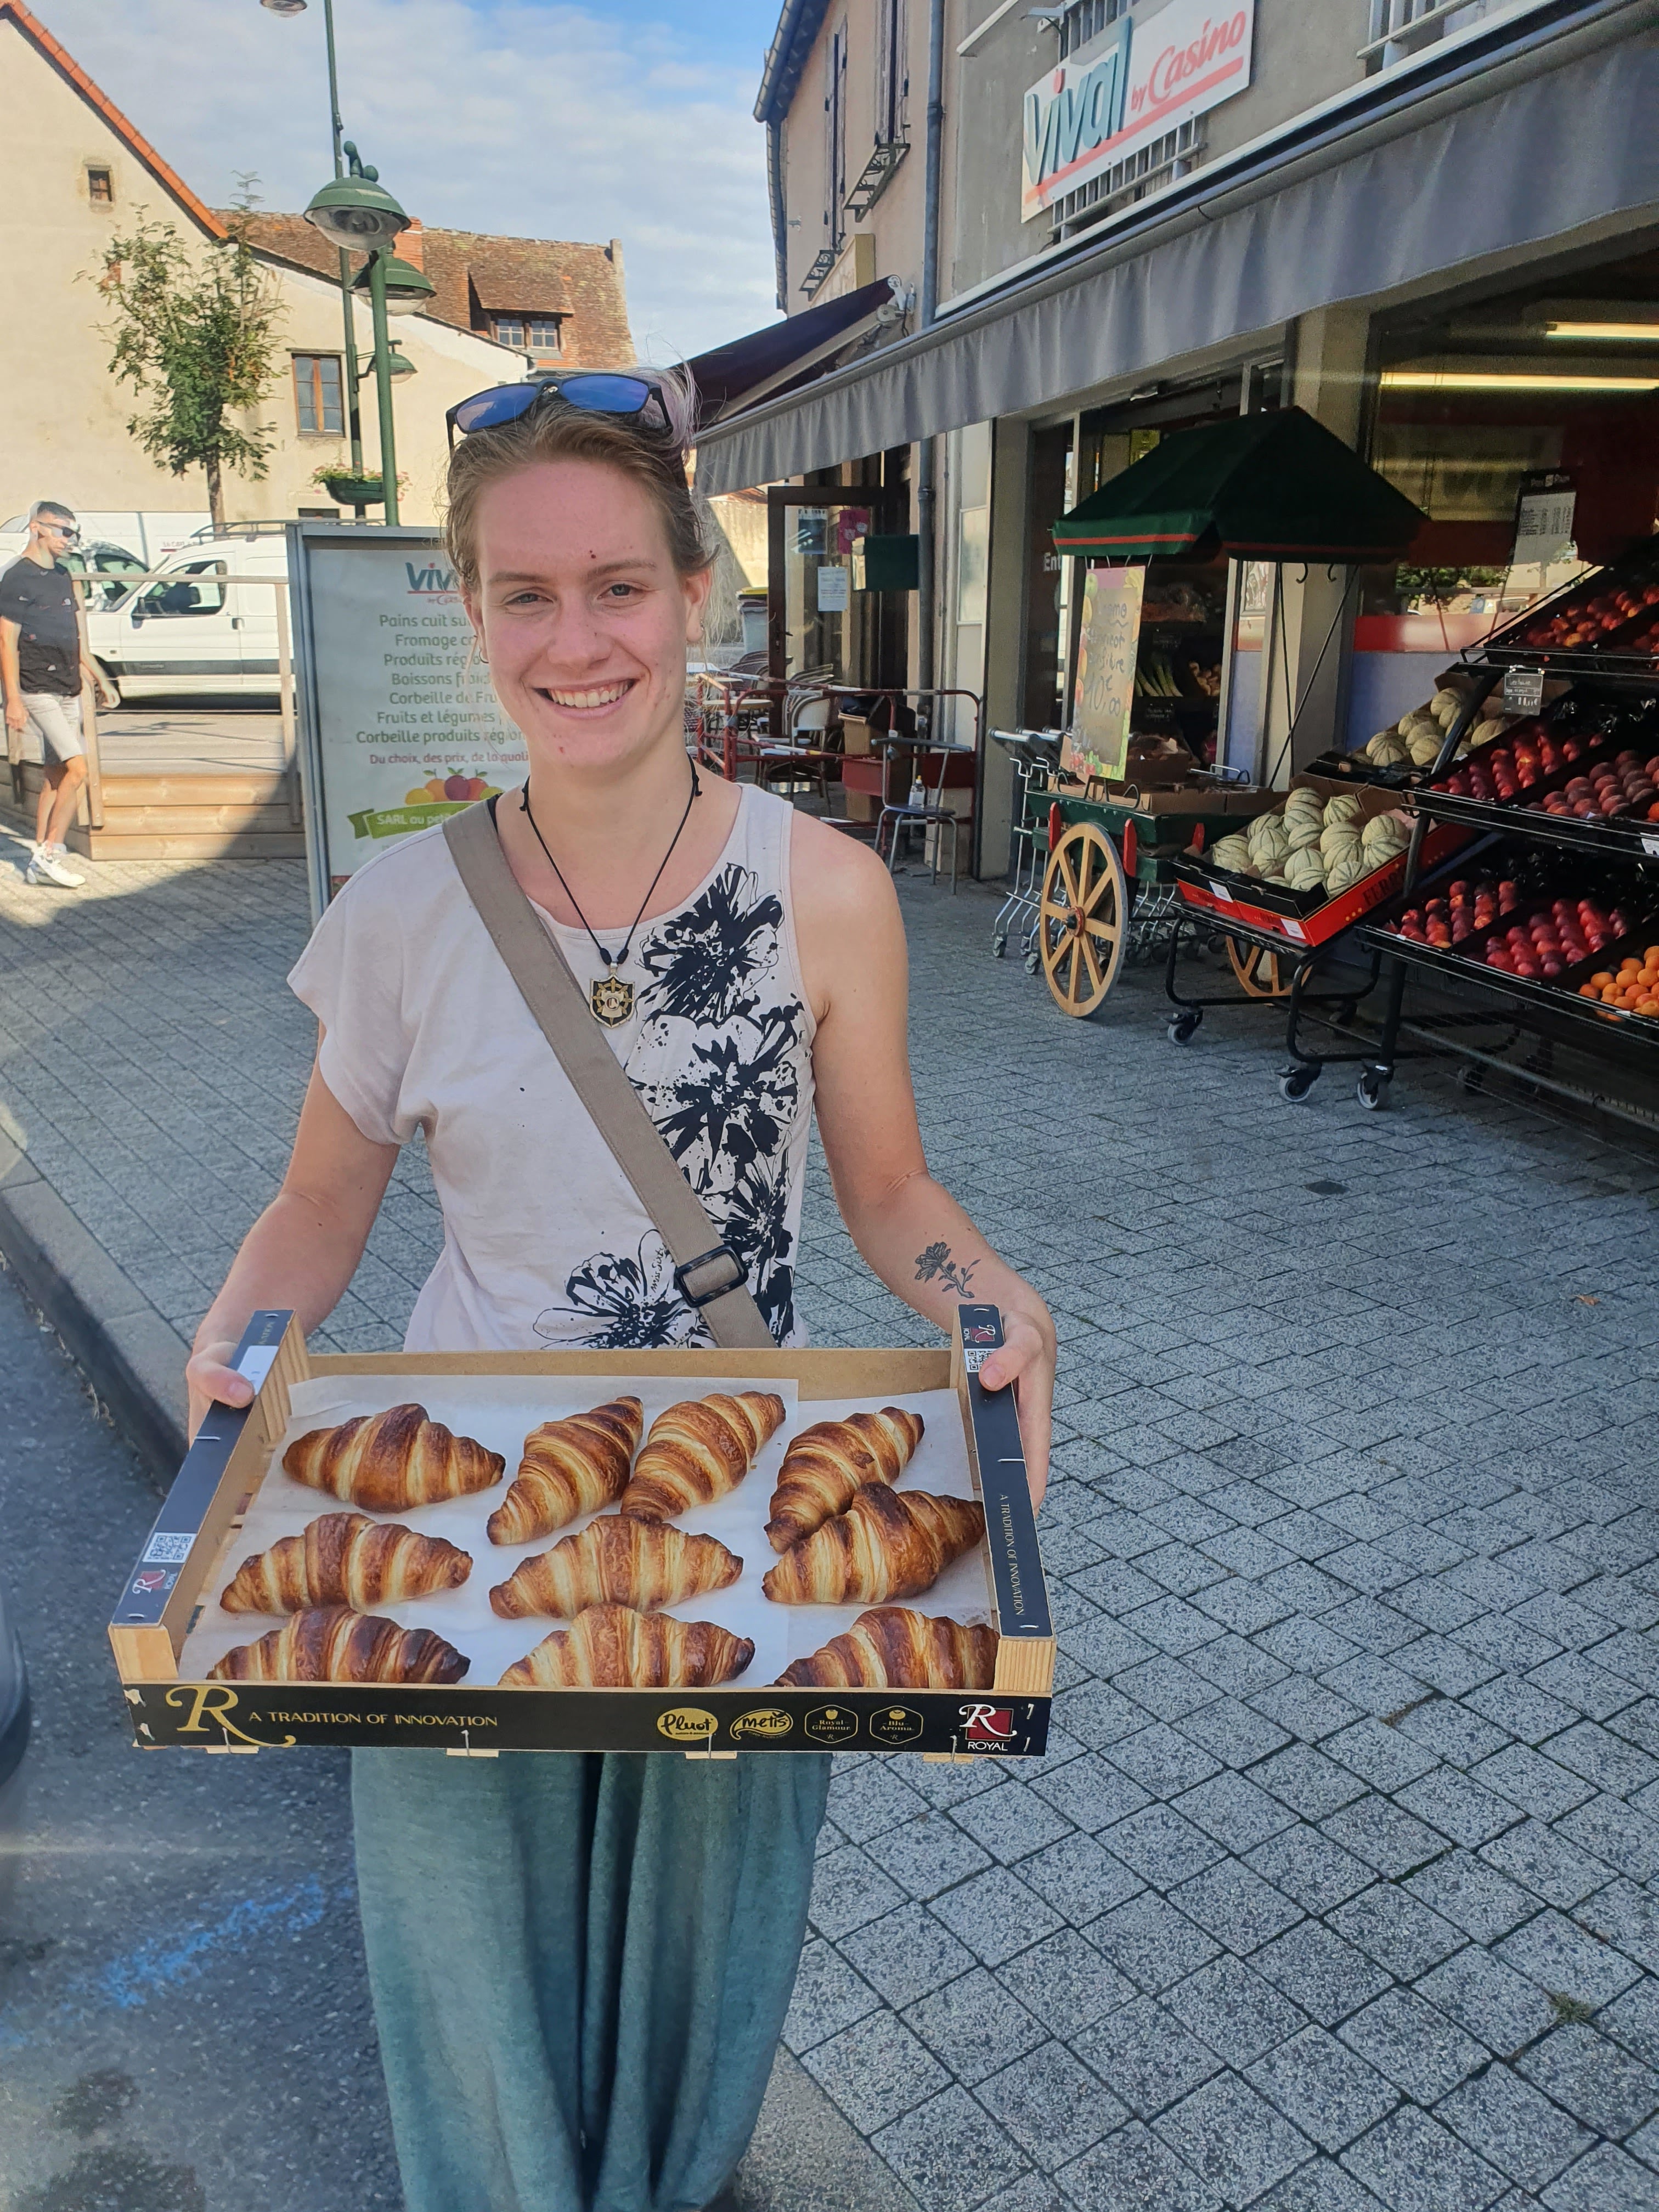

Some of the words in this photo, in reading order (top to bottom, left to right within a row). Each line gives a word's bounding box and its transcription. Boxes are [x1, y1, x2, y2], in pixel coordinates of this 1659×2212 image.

[1025, 15, 1132, 185] Vival
[1131, 82, 1147, 112] by
[1148, 11, 1246, 104] Casino
[405, 562, 453, 591] Viv
[379, 614, 418, 627] Pains
[421, 614, 448, 627] cuit
[395, 634, 458, 650] Fromage
[384, 653, 443, 666] Produits
[392, 673, 452, 685] Boissons
[390, 692, 452, 704] Corbeille
[476, 691, 496, 703] Fru
[377, 712, 416, 724] Fruits
[421, 712, 433, 723] et
[438, 712, 495, 727] légumes
[356, 731, 420, 743] Corbeille
[424, 730, 480, 745] produits
[370, 754, 385, 764] Du
[388, 753, 420, 764] choix,
[424, 753, 441, 763] des
[445, 753, 469, 765] prix,
[471, 752, 484, 762] de
[487, 752, 498, 762] la
[500, 751, 529, 764] quali
[975, 1324, 996, 1344] R
[1001, 1504, 1014, 1547] TRADITION
[1007, 1549, 1017, 1561] OF
[1009, 1563, 1025, 1616] INNOVATION
[249, 1712, 262, 1722] A
[268, 1711, 362, 1723] TRADITION
[366, 1713, 388, 1724] OF
[396, 1714, 498, 1726] INNOVATION
[661, 1713, 712, 1735] Pluot
[959, 1703, 1018, 1737] R
[968, 1741, 1008, 1752] ROYAL
